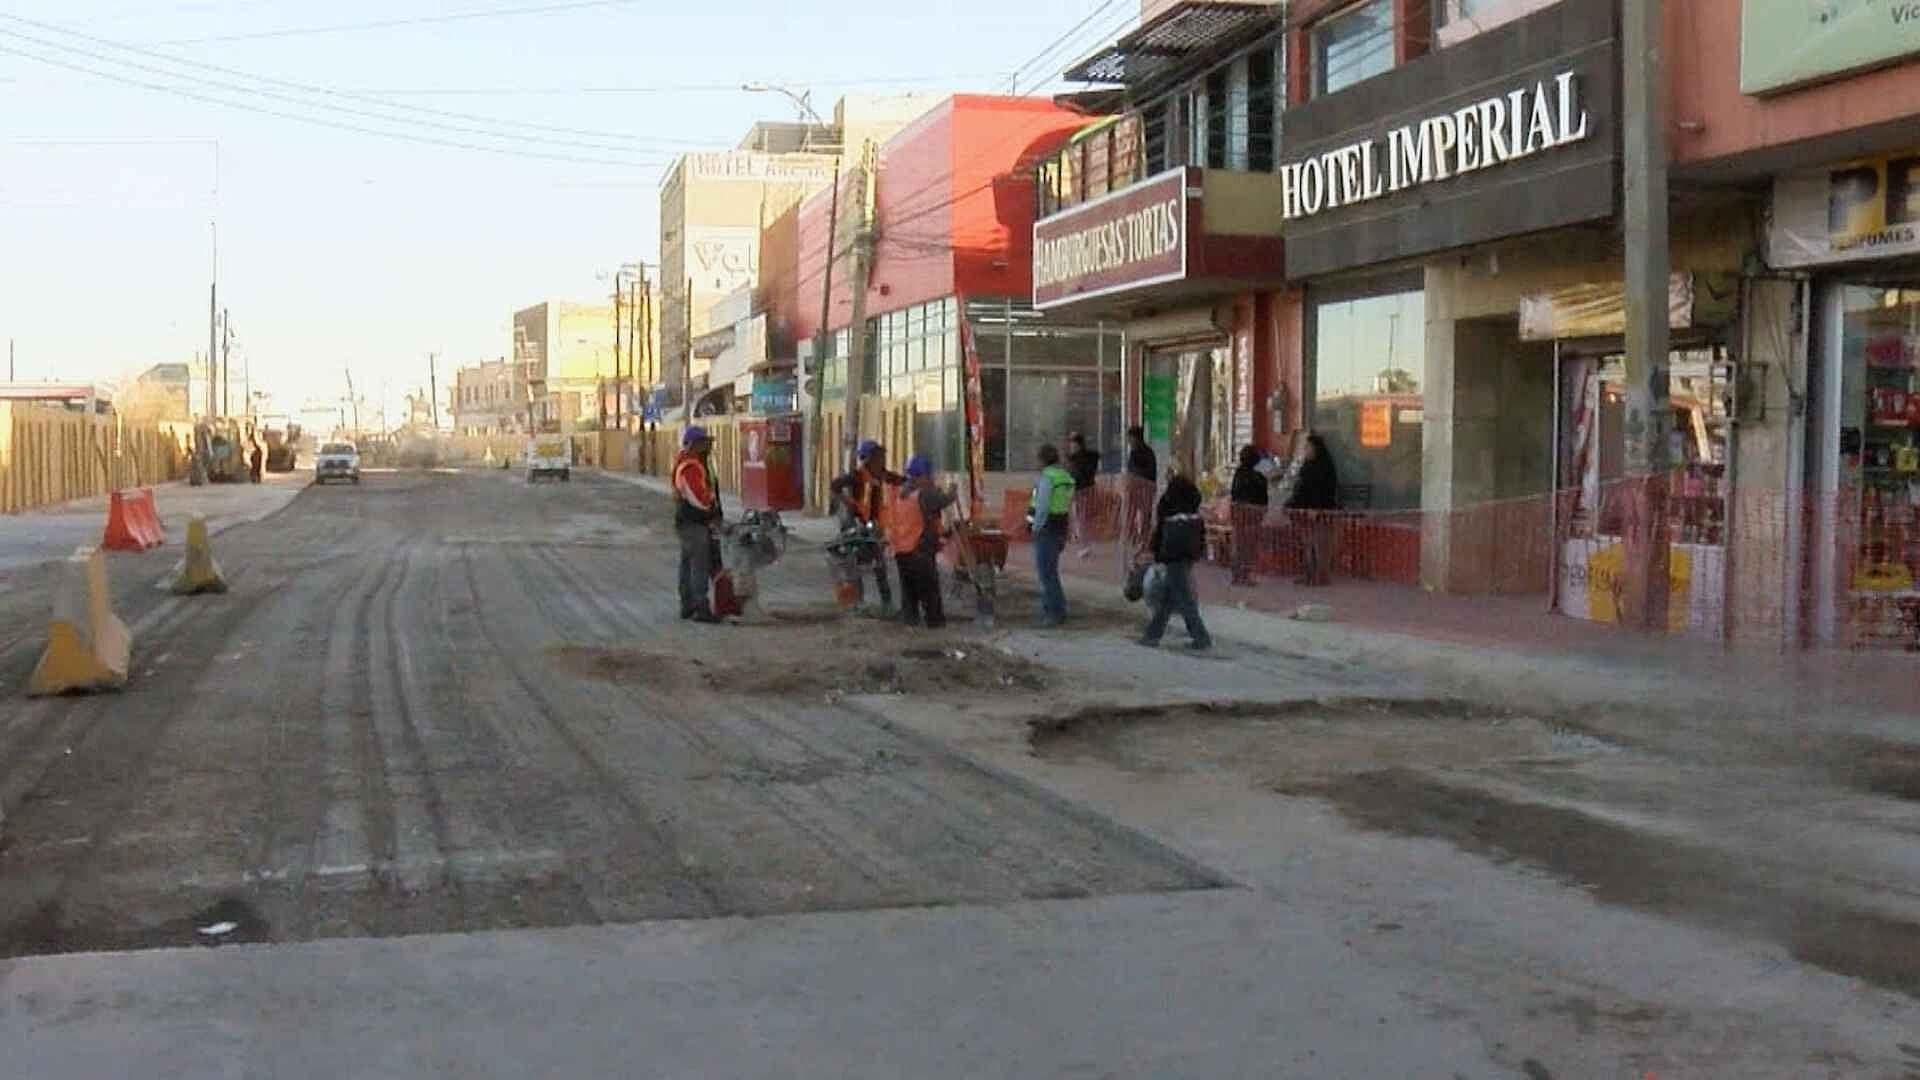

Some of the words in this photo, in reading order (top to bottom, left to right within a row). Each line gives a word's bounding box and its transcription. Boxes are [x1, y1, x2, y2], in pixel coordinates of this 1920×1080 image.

[1281, 140, 1382, 219] HOTEL
[1388, 69, 1587, 191] IMPERIAL
[1035, 219, 1124, 288] HAMBURGUESAS
[1125, 199, 1179, 264] TORTAS
